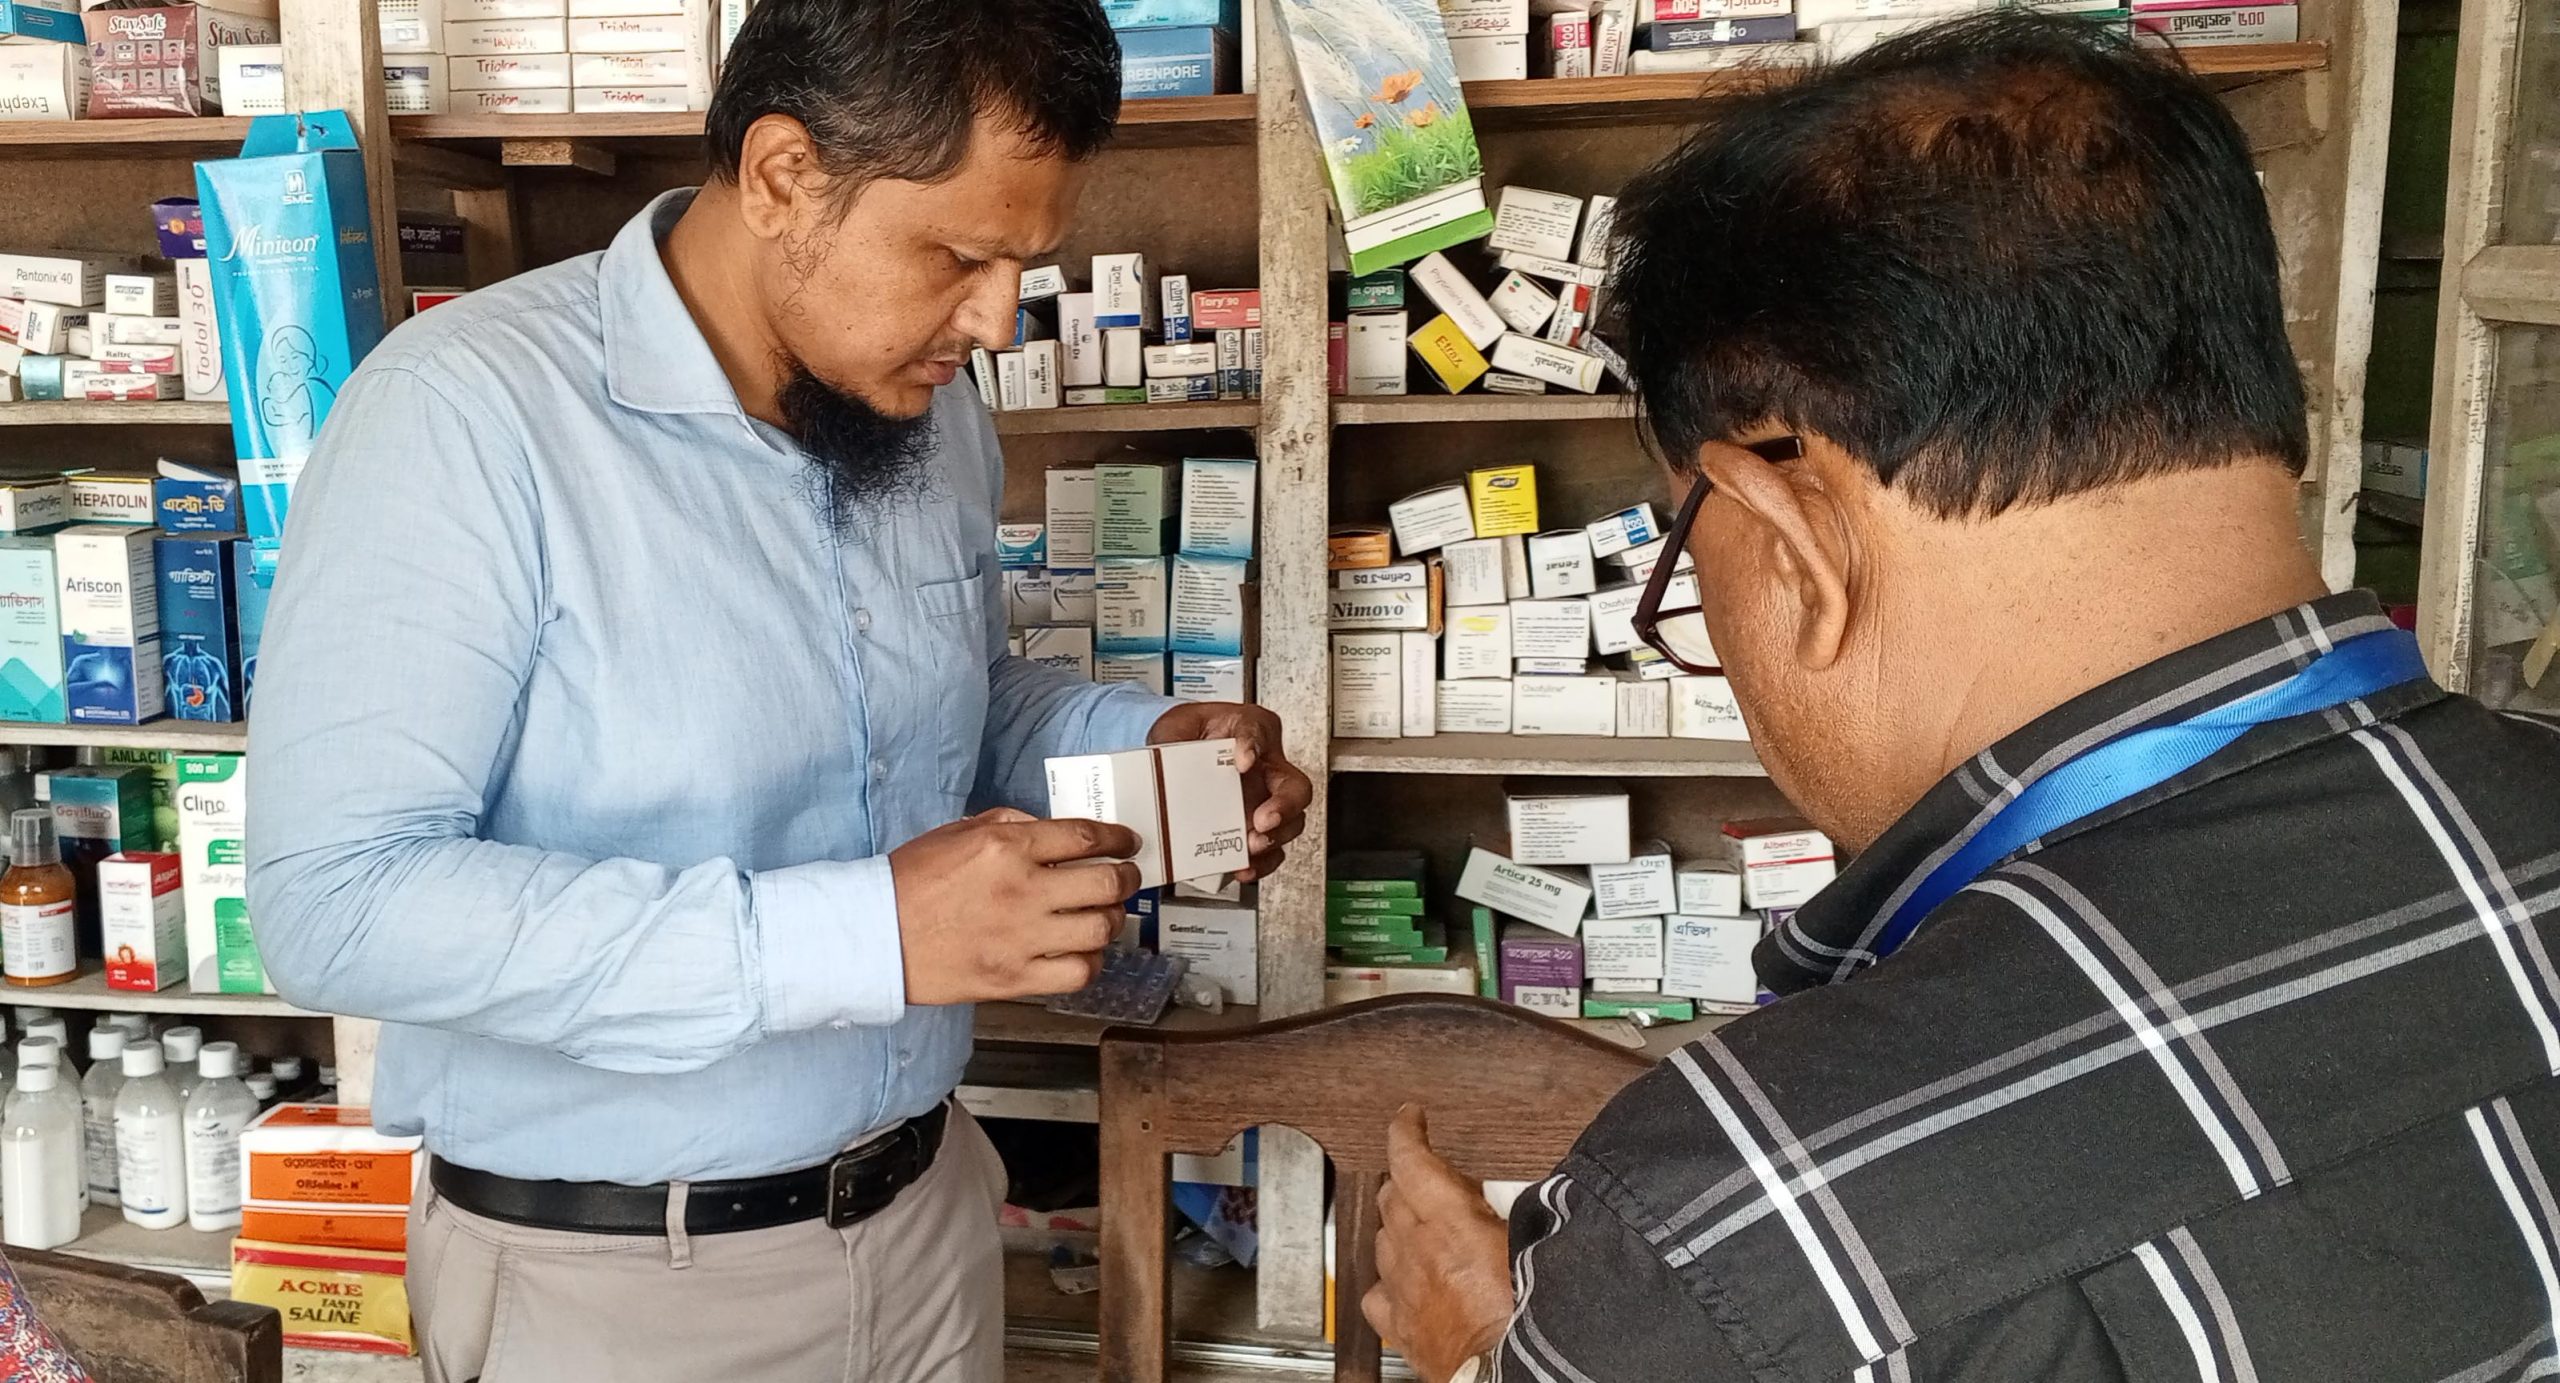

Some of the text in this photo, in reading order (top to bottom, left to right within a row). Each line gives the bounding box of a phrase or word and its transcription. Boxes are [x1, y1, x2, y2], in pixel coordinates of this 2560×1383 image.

[108, 14, 166, 33] Stay Safe
[207, 22, 242, 47] Stay
[476, 58, 518, 73] Trialon
[477, 92, 518, 107] Trialon
[282, 194, 314, 207] SMC
[217, 225, 317, 262] Minicon
[16, 267, 74, 285] Pantonix 40
[1199, 296, 1226, 309] Tory
[190, 284, 212, 378] Todol 30
[72, 492, 148, 509] HEPATOLIN
[1546, 560, 1580, 570] Fenat
[65, 576, 123, 594] Ariscon
[1353, 574, 1369, 585] DS
[1331, 602, 1404, 619] Nimovo
[1340, 645, 1391, 658] Docopa
[206, 762, 219, 774] ml
[1493, 864, 1562, 896] Artica 25 mg
[278, 1279, 363, 1298] ACME
[321, 1298, 362, 1310] TASTY
[289, 1307, 362, 1326] SALINE
